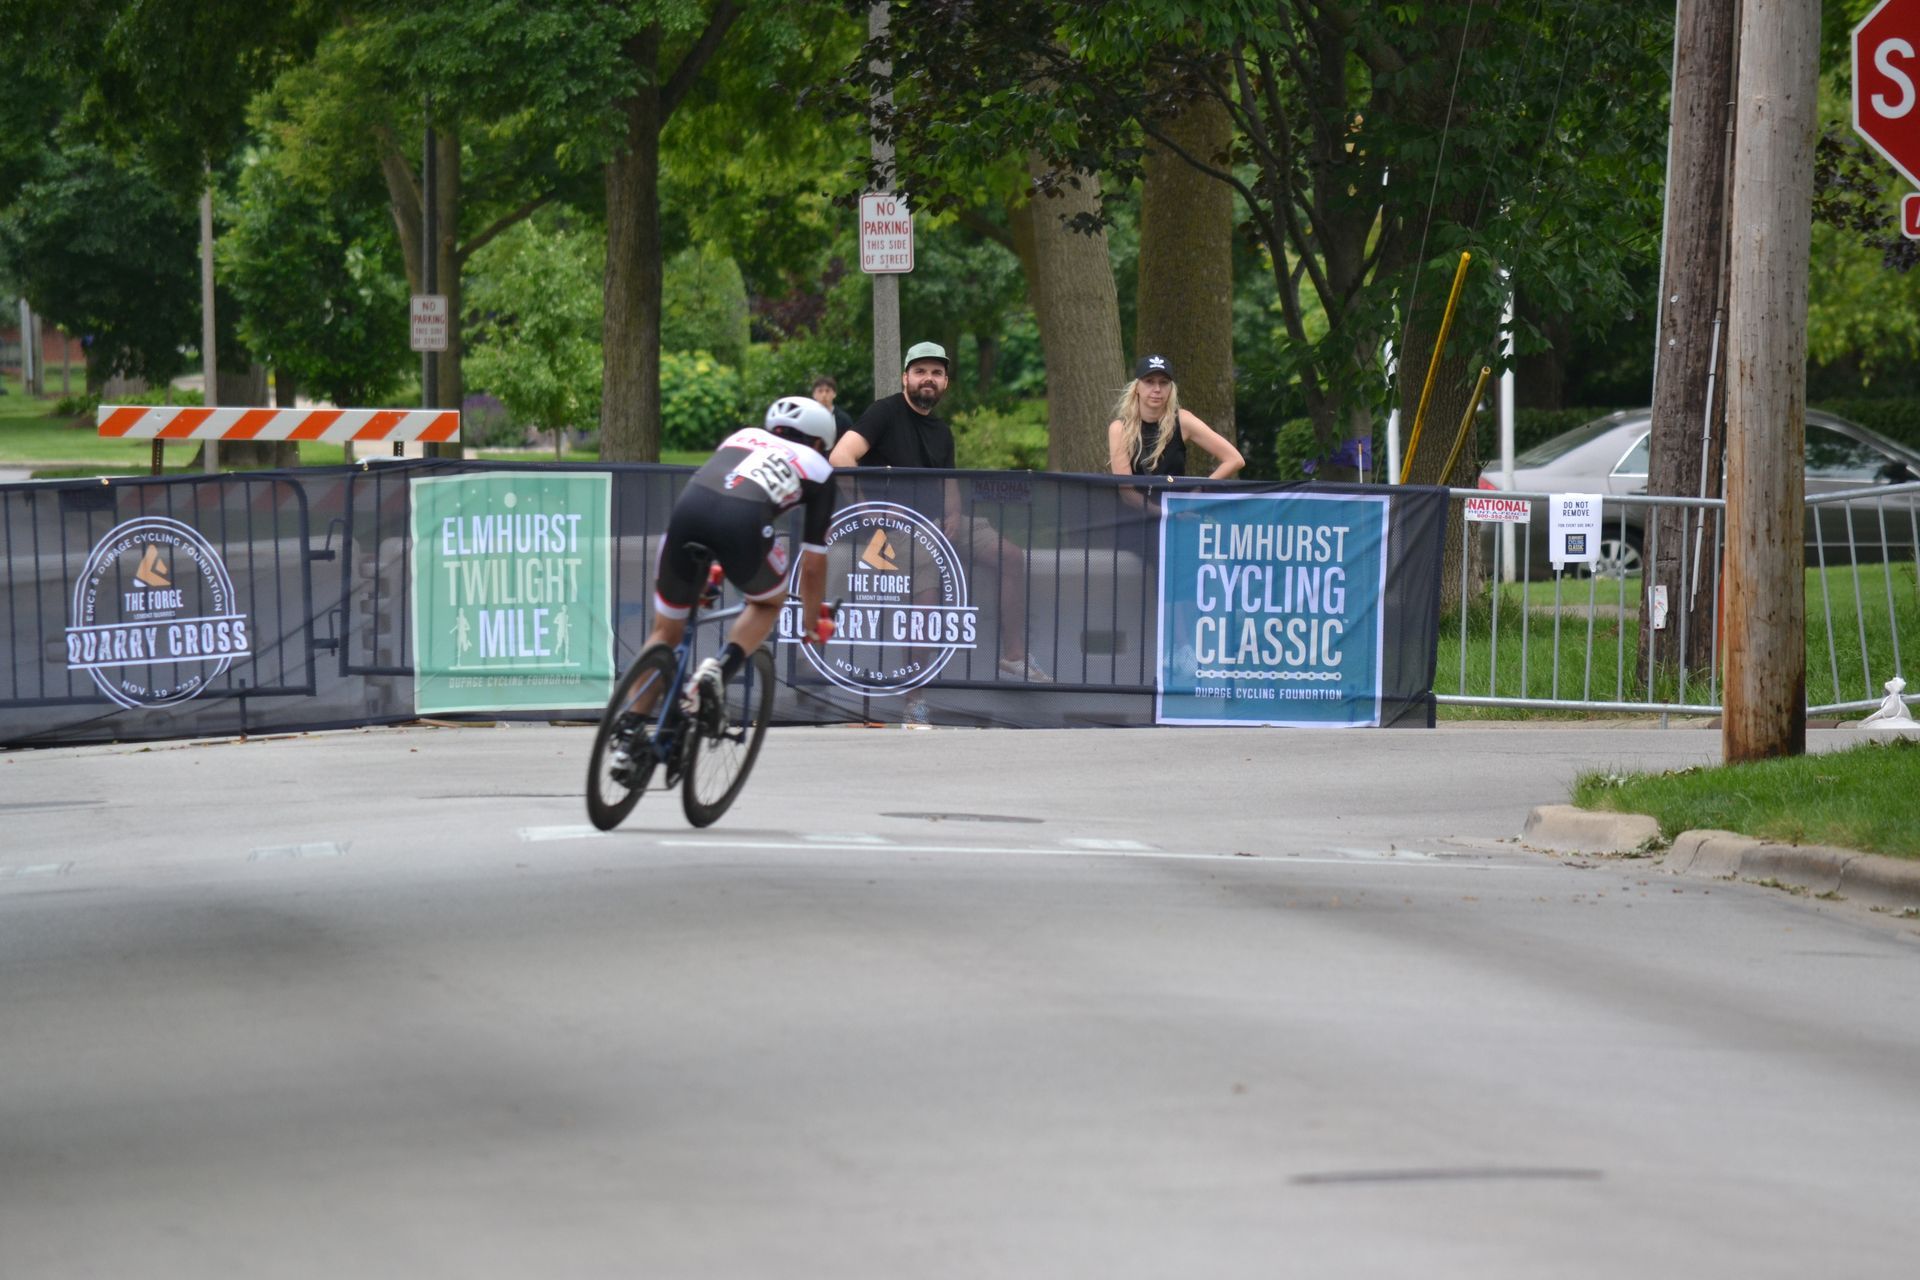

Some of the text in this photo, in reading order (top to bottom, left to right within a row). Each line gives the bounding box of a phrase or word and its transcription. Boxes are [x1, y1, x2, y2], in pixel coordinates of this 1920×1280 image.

[876, 202, 895, 216] NO
[864, 221, 909, 235] PARKING
[867, 240, 907, 250] THIS SIDE
[865, 254, 909, 265] OF STREET
[414, 315, 445, 324] PARKING
[751, 453, 792, 491] 215
[1468, 499, 1528, 512] NATIONAL
[1563, 509, 1590, 517] REMOVE
[1564, 501, 1589, 509] DO NOT
[441, 513, 582, 556] ELMHURST
[1198, 523, 1349, 562] ELMHURST
[826, 517, 953, 602] UPAGE CYCLING FOUNDATION
[86, 533, 223, 622] EMC2 & DUPAGE CYCLING FOUNDATION
[443, 558, 582, 607] TWILIGHT
[847, 573, 911, 594] THE FORGE
[1196, 564, 1345, 614] CYCLING
[124, 589, 184, 612] THE FORGE
[479, 608, 551, 658] MILE
[893, 610, 977, 642] CROSS
[66, 621, 248, 664] QUARRY CROSS
[1195, 616, 1343, 666] CLASSIC
[836, 658, 921, 681] NOV. 19. 2023
[122, 680, 149, 697] NOV.
[1195, 687, 1343, 700] DUPAGE CYCLING FOUNDATION
